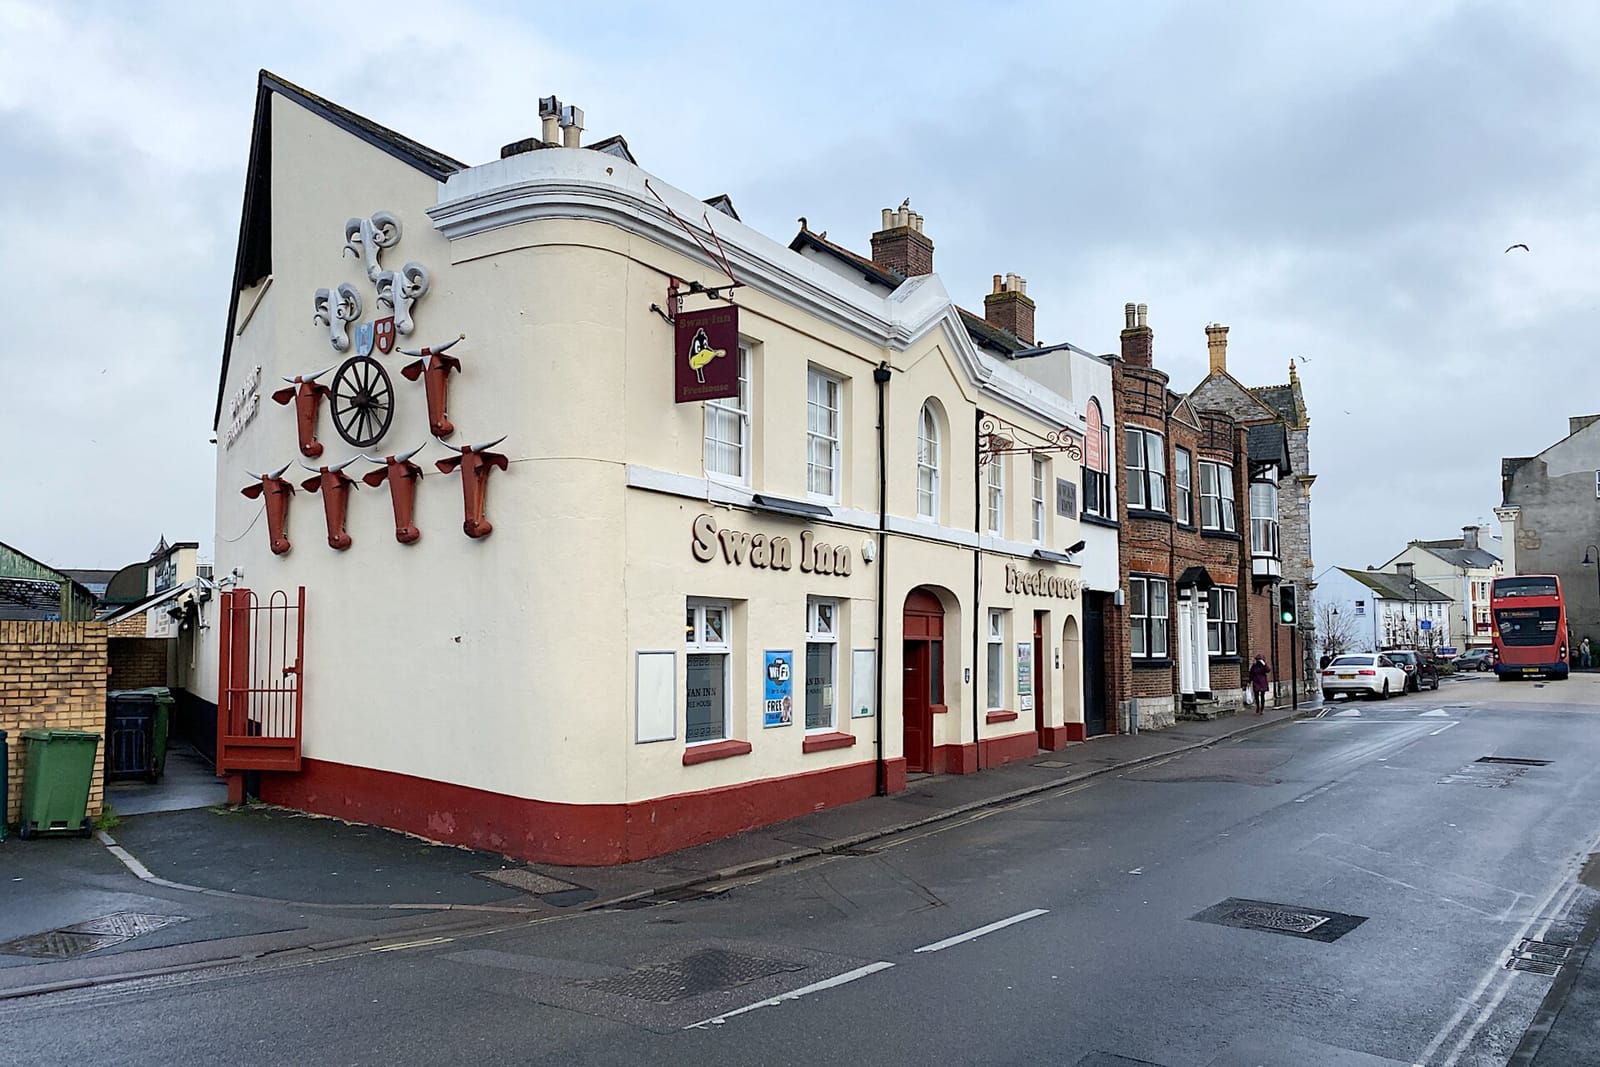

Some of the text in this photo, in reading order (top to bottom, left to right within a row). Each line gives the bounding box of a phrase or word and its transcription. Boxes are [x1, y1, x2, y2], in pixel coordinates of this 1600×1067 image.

[679, 314, 731, 329] Swan Inn
[682, 383, 729, 396] Freehouse
[692, 513, 852, 577] Swan Inn
[1005, 562, 1078, 600] Freehouse
[767, 700, 782, 713] FREE
